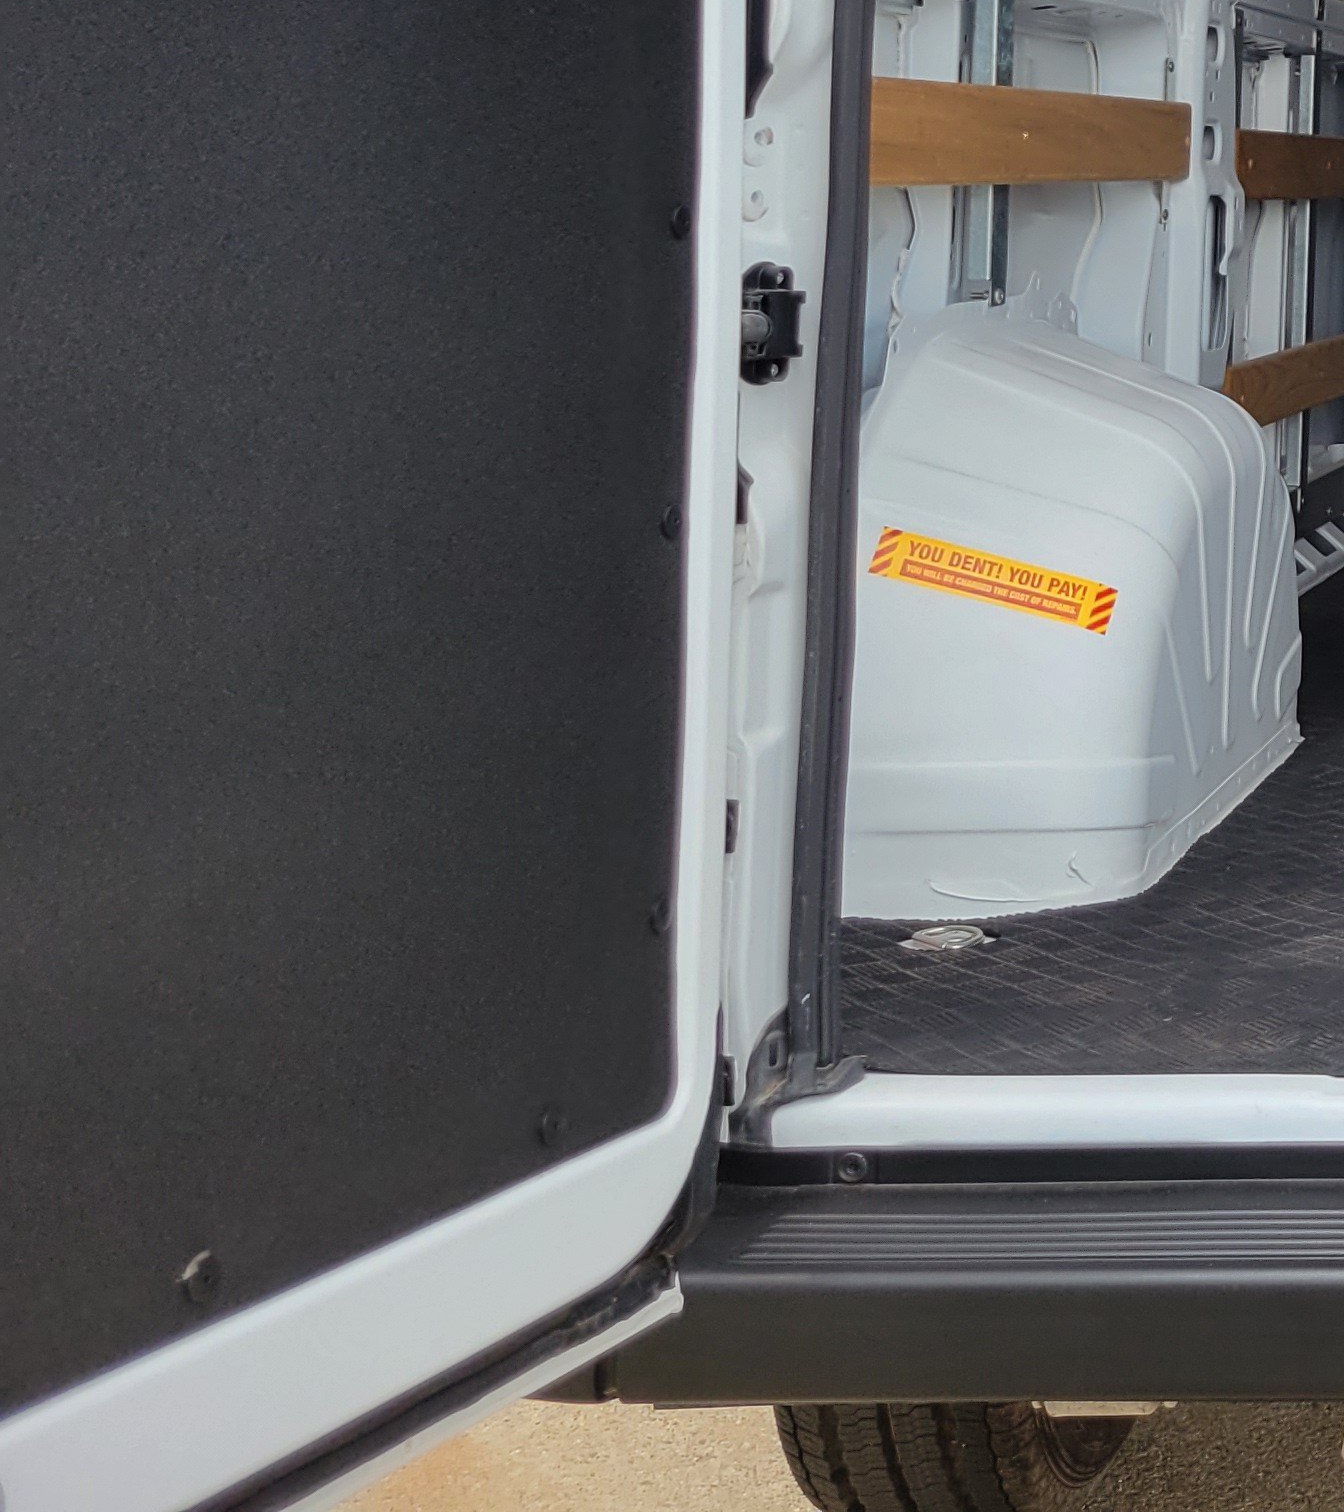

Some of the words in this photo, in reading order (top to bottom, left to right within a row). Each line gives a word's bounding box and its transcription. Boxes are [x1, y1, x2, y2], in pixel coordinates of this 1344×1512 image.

[906, 563, 922, 576] YOU
[908, 540, 945, 563] YOU
[947, 551, 1005, 580] DENT!
[1007, 566, 1045, 589] YOU
[1047, 578, 1089, 601] PAY!
